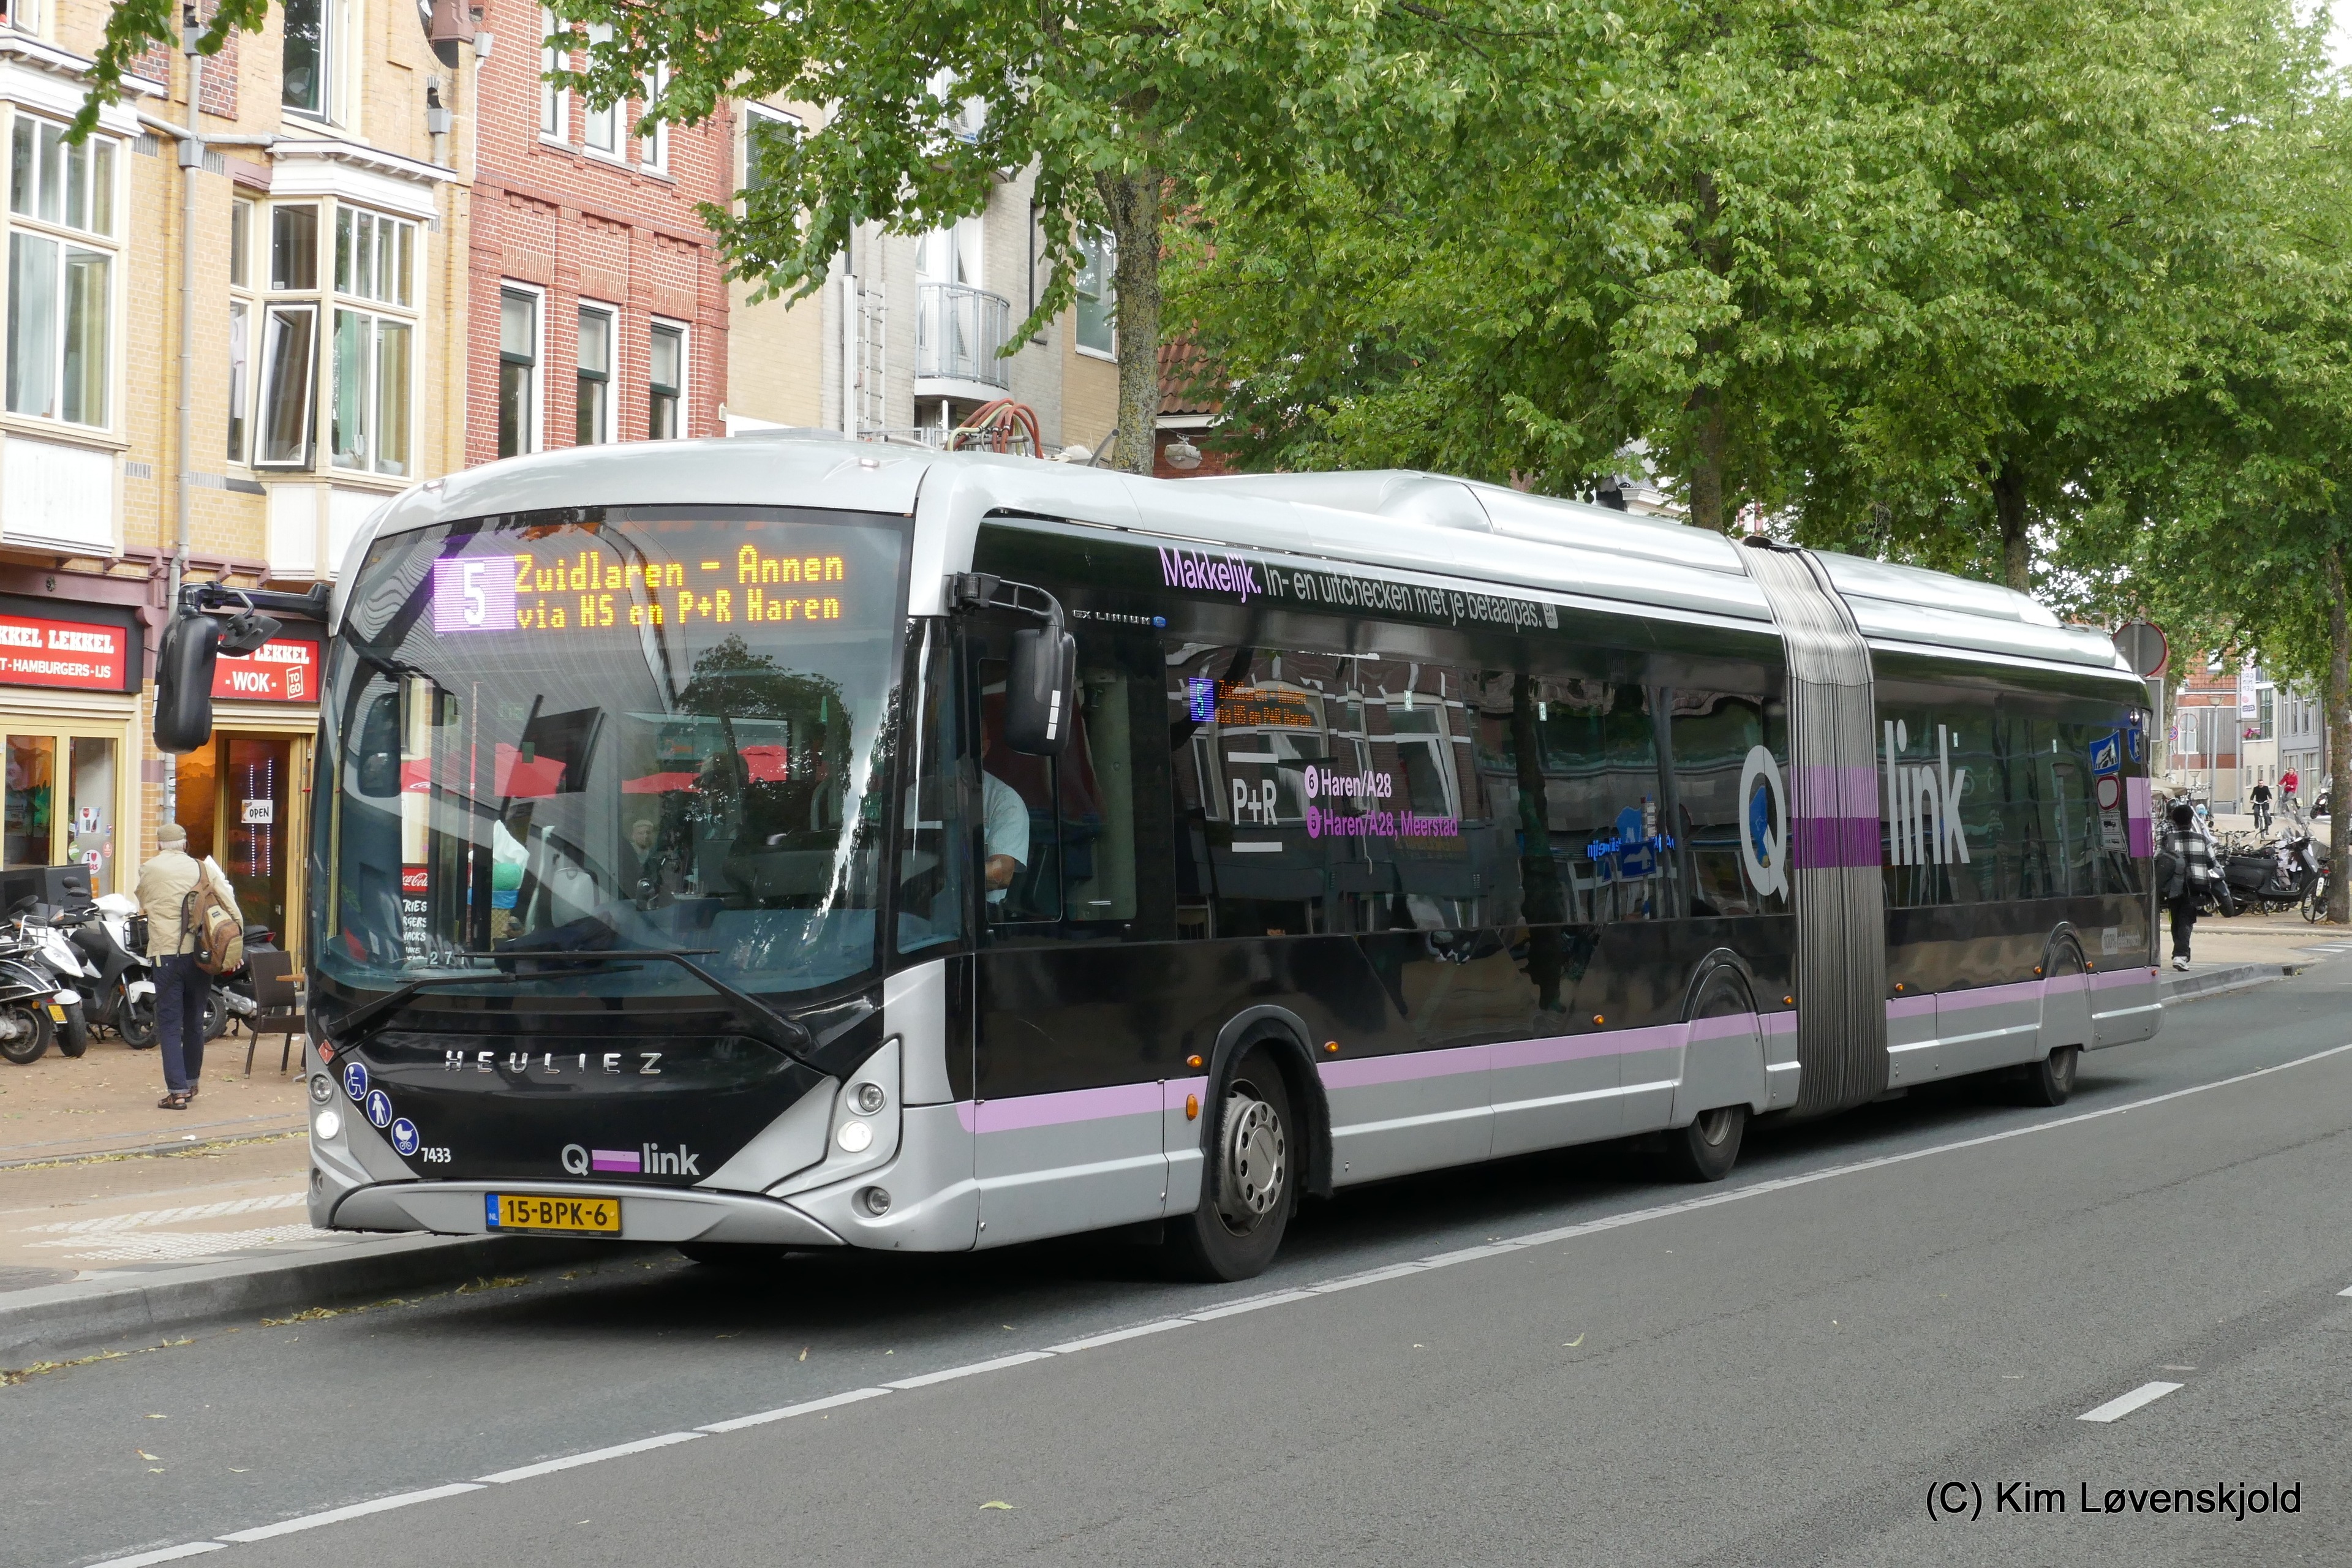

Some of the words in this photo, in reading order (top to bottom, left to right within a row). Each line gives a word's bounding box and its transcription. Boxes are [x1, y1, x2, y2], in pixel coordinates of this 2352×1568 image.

[514, 551, 683, 592] Zuidlaren
[739, 545, 842, 584] Annen
[463, 562, 485, 625] 5
[1158, 546, 1262, 603] Makkelijk.
[1261, 558, 1289, 597] In-
[1294, 572, 1317, 600] en
[1319, 568, 1413, 611] uitchecken
[1414, 586, 1448, 616] met
[1447, 585, 1464, 626] je
[1464, 587, 1542, 633] betaalpas.
[516, 600, 565, 628] via
[581, 594, 613, 627] HS
[630, 604, 663, 625] en
[678, 589, 731, 624] P+R
[747, 589, 839, 621] Haren
[48, 630, 115, 654] LEKKEL
[254, 644, 309, 664] LEKKEL
[289, 673, 300, 684] TO
[289, 683, 301, 694] GO
[1321, 768, 1392, 798] Haren/A28
[249, 805, 270, 819] OPEN
[1232, 778, 1278, 825] P+R
[1738, 744, 1789, 904] Q
[1884, 718, 1970, 865] link
[1323, 808, 1398, 841] Haren/A28,
[1401, 810, 1458, 837] Meerstad
[403, 916, 427, 928] RGERS
[445, 1050, 663, 1074] HEULIEZ
[421, 1147, 451, 1163] 7433
[562, 1144, 589, 1177] Q
[643, 1142, 700, 1175] link
[508, 1200, 608, 1226] 15-BPK-6
